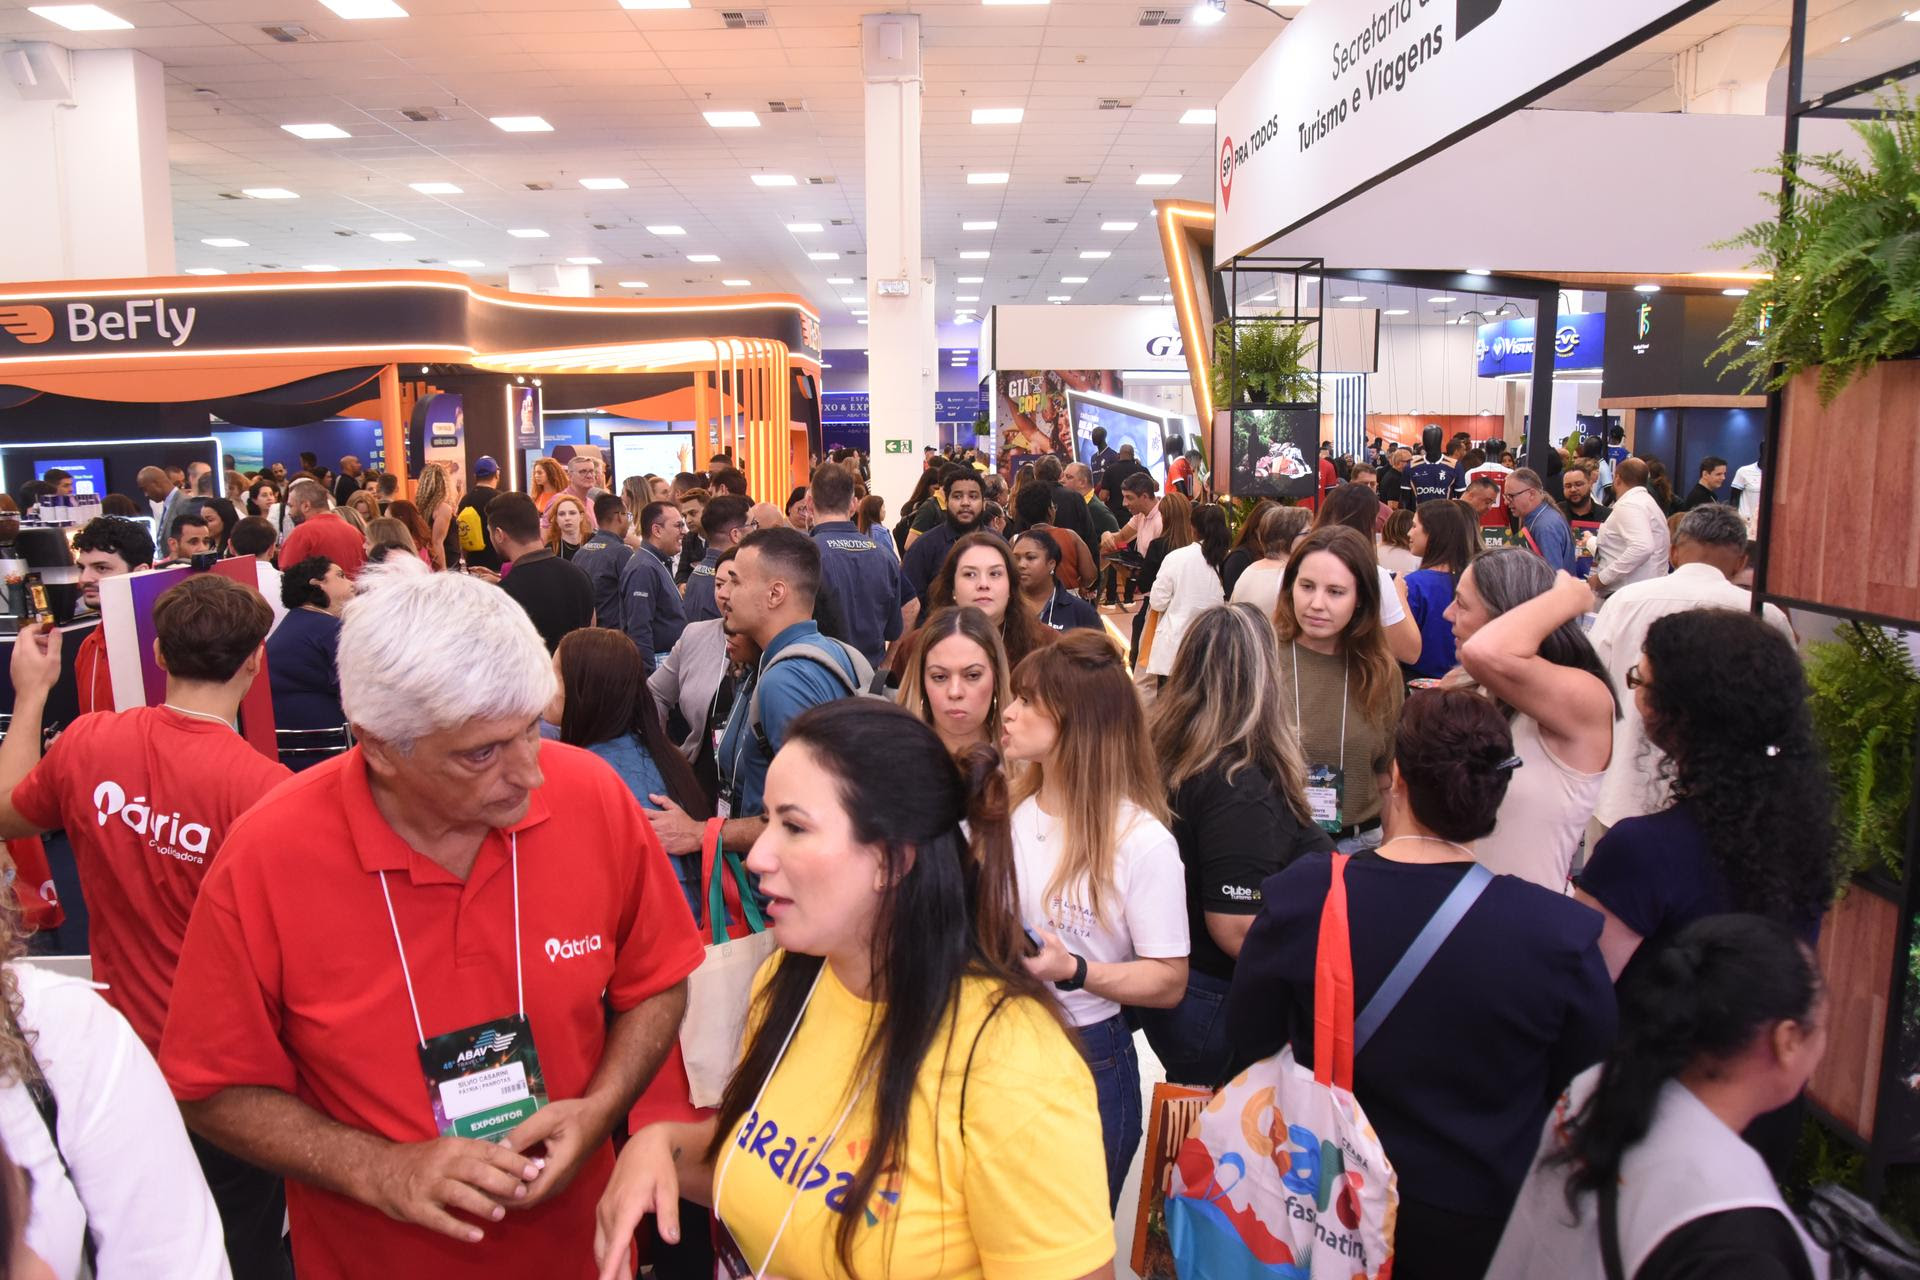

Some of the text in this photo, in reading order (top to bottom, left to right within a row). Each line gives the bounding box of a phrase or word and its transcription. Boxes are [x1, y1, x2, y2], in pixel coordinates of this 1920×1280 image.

[1332, 0, 1411, 81] Secretaria
[1298, 24, 1443, 153] Turismo e Viagens
[1222, 113, 1279, 178] SP PRA TODOS
[67, 298, 196, 347] BeFly
[1008, 377, 1029, 398] GTA
[823, 404, 838, 412] XO
[840, 404, 847, 412] &
[826, 539, 869, 549] PANROTAS
[1485, 537, 1503, 547] EM
[93, 780, 211, 854] Pária
[1221, 884, 1252, 896] Clube
[545, 934, 602, 963] Pátria
[456, 1046, 487, 1064] ABAV
[458, 1069, 509, 1088] SILVIO CASARINI
[471, 1109, 523, 1132] EXPOSITOR
